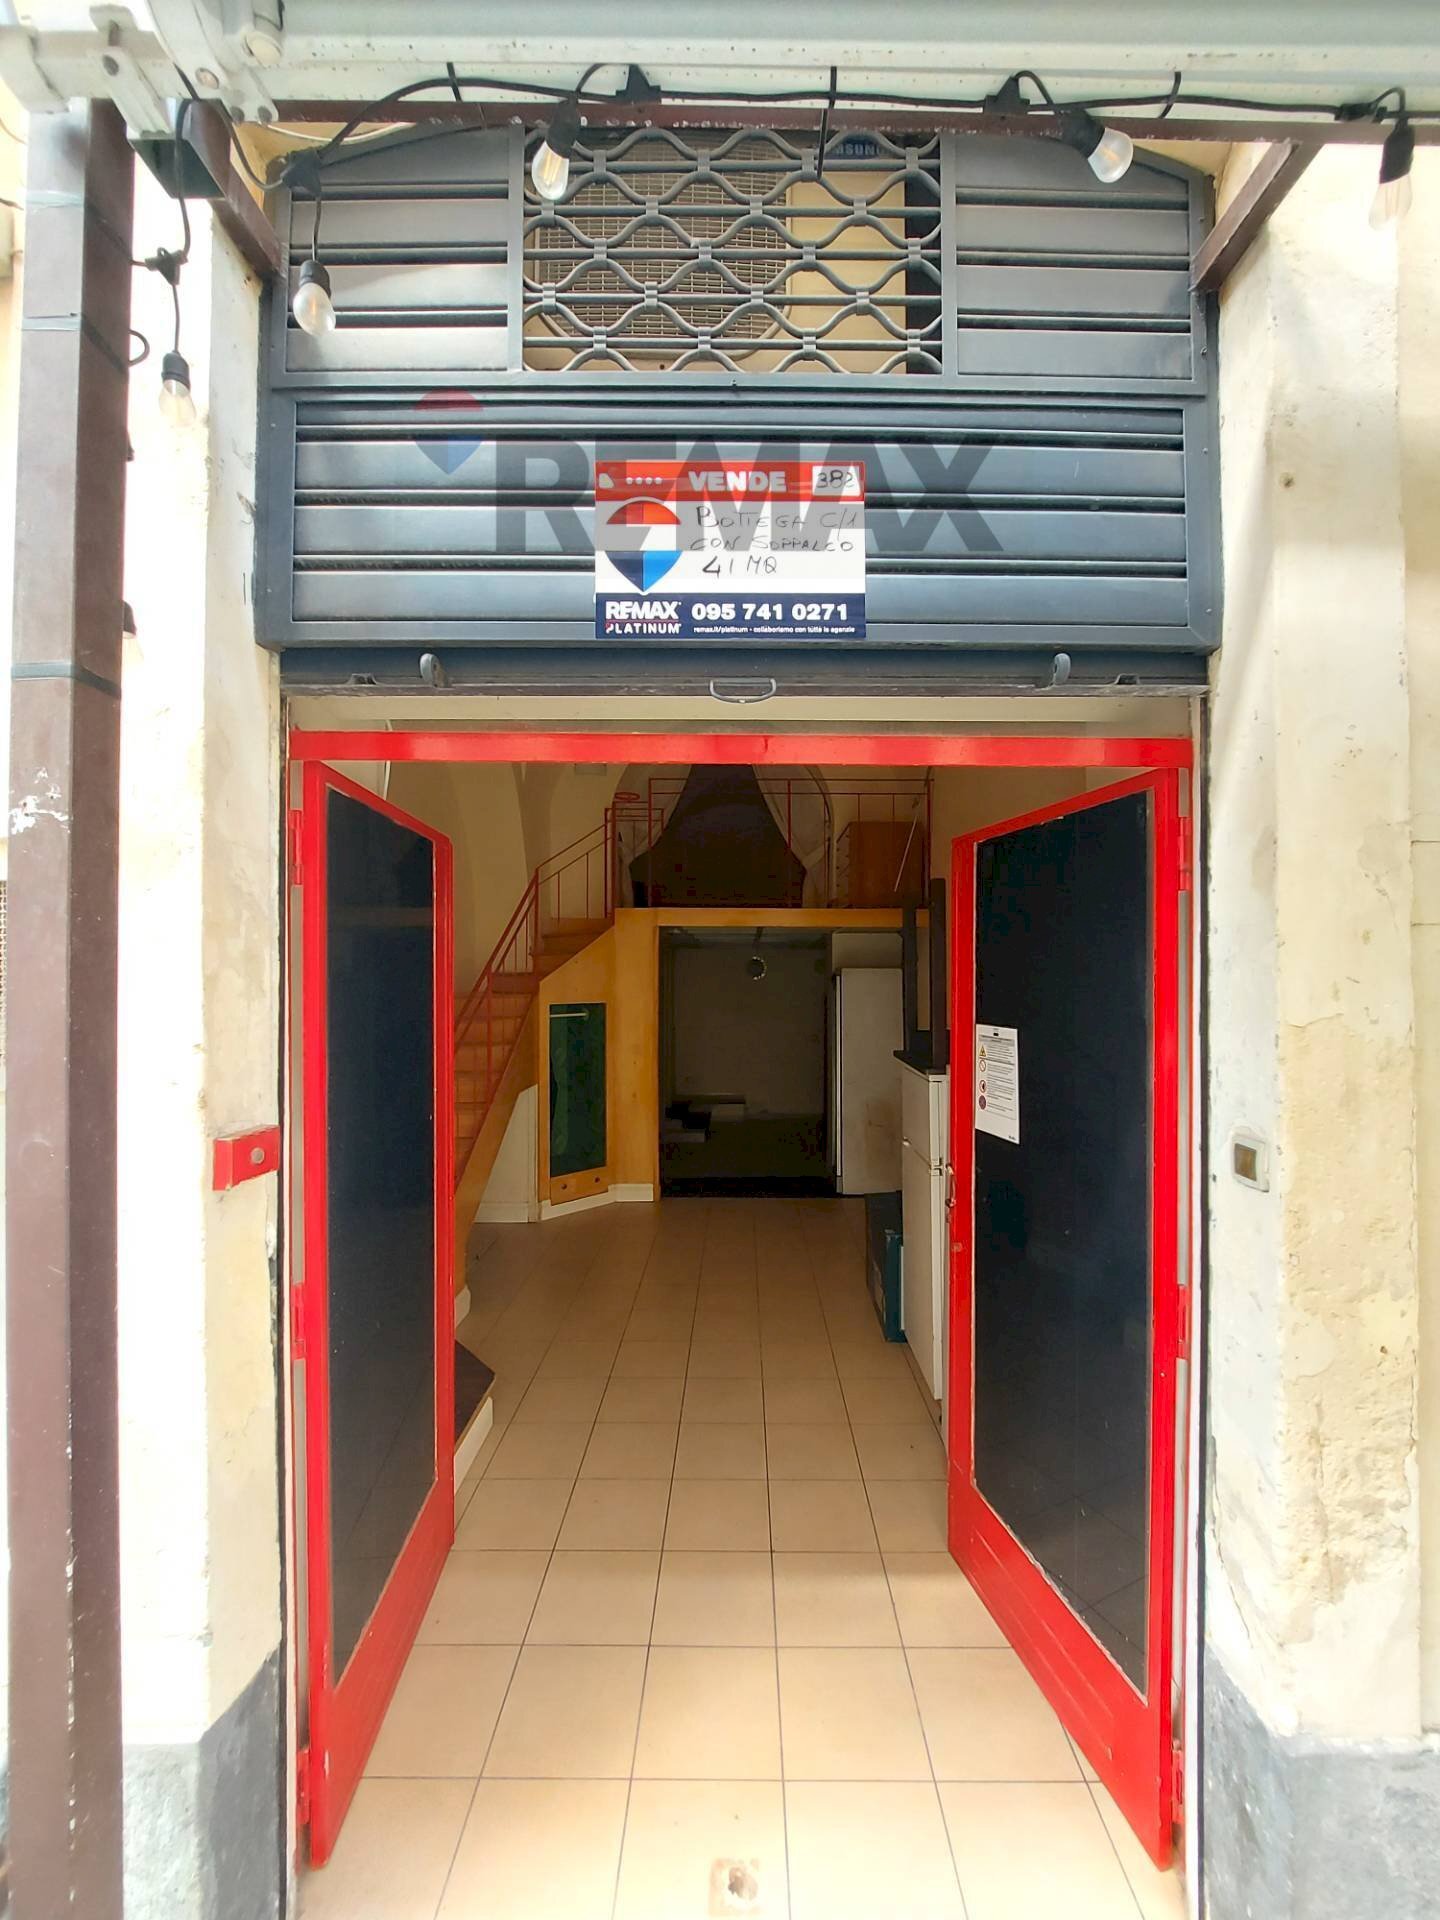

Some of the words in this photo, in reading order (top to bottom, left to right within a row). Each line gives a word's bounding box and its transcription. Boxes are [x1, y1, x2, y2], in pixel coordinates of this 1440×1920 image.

[688, 471, 787, 492] VENDE
[696, 506, 806, 528] BOTTEGA
[690, 535, 741, 551] CON
[752, 535, 854, 552] SOPPALCO
[702, 556, 733, 578] 41
[747, 555, 778, 574] MQ
[605, 601, 680, 619] REMAX
[691, 603, 736, 620] 095
[743, 603, 783, 620] 741
[792, 603, 848, 620] 0271
[605, 622, 681, 634] PLATINUM
